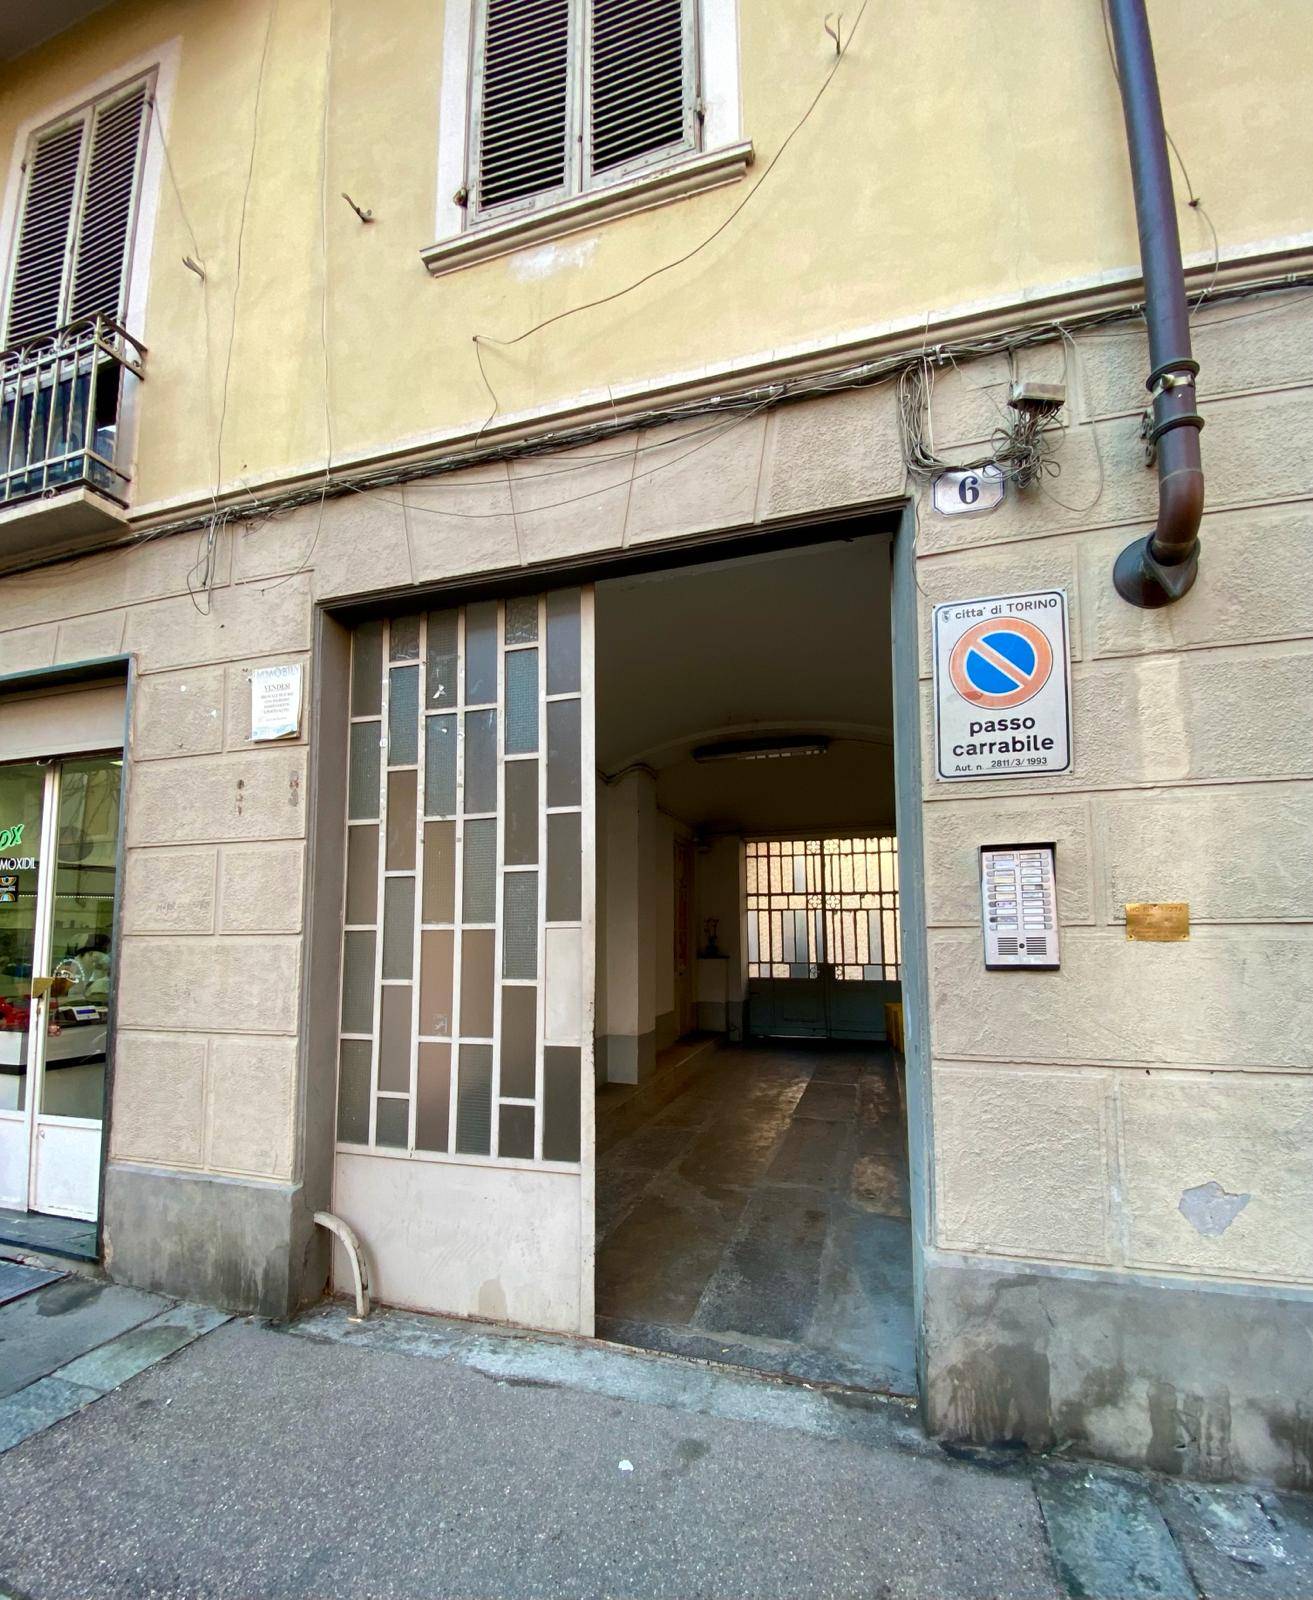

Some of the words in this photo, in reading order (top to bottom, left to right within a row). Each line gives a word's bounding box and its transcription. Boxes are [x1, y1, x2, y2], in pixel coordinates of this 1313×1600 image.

[959, 475, 979, 505] 6
[990, 604, 1002, 615] di
[1006, 599, 1057, 612] TORINO
[969, 716, 1036, 737] passo
[952, 734, 1055, 757] carrabile
